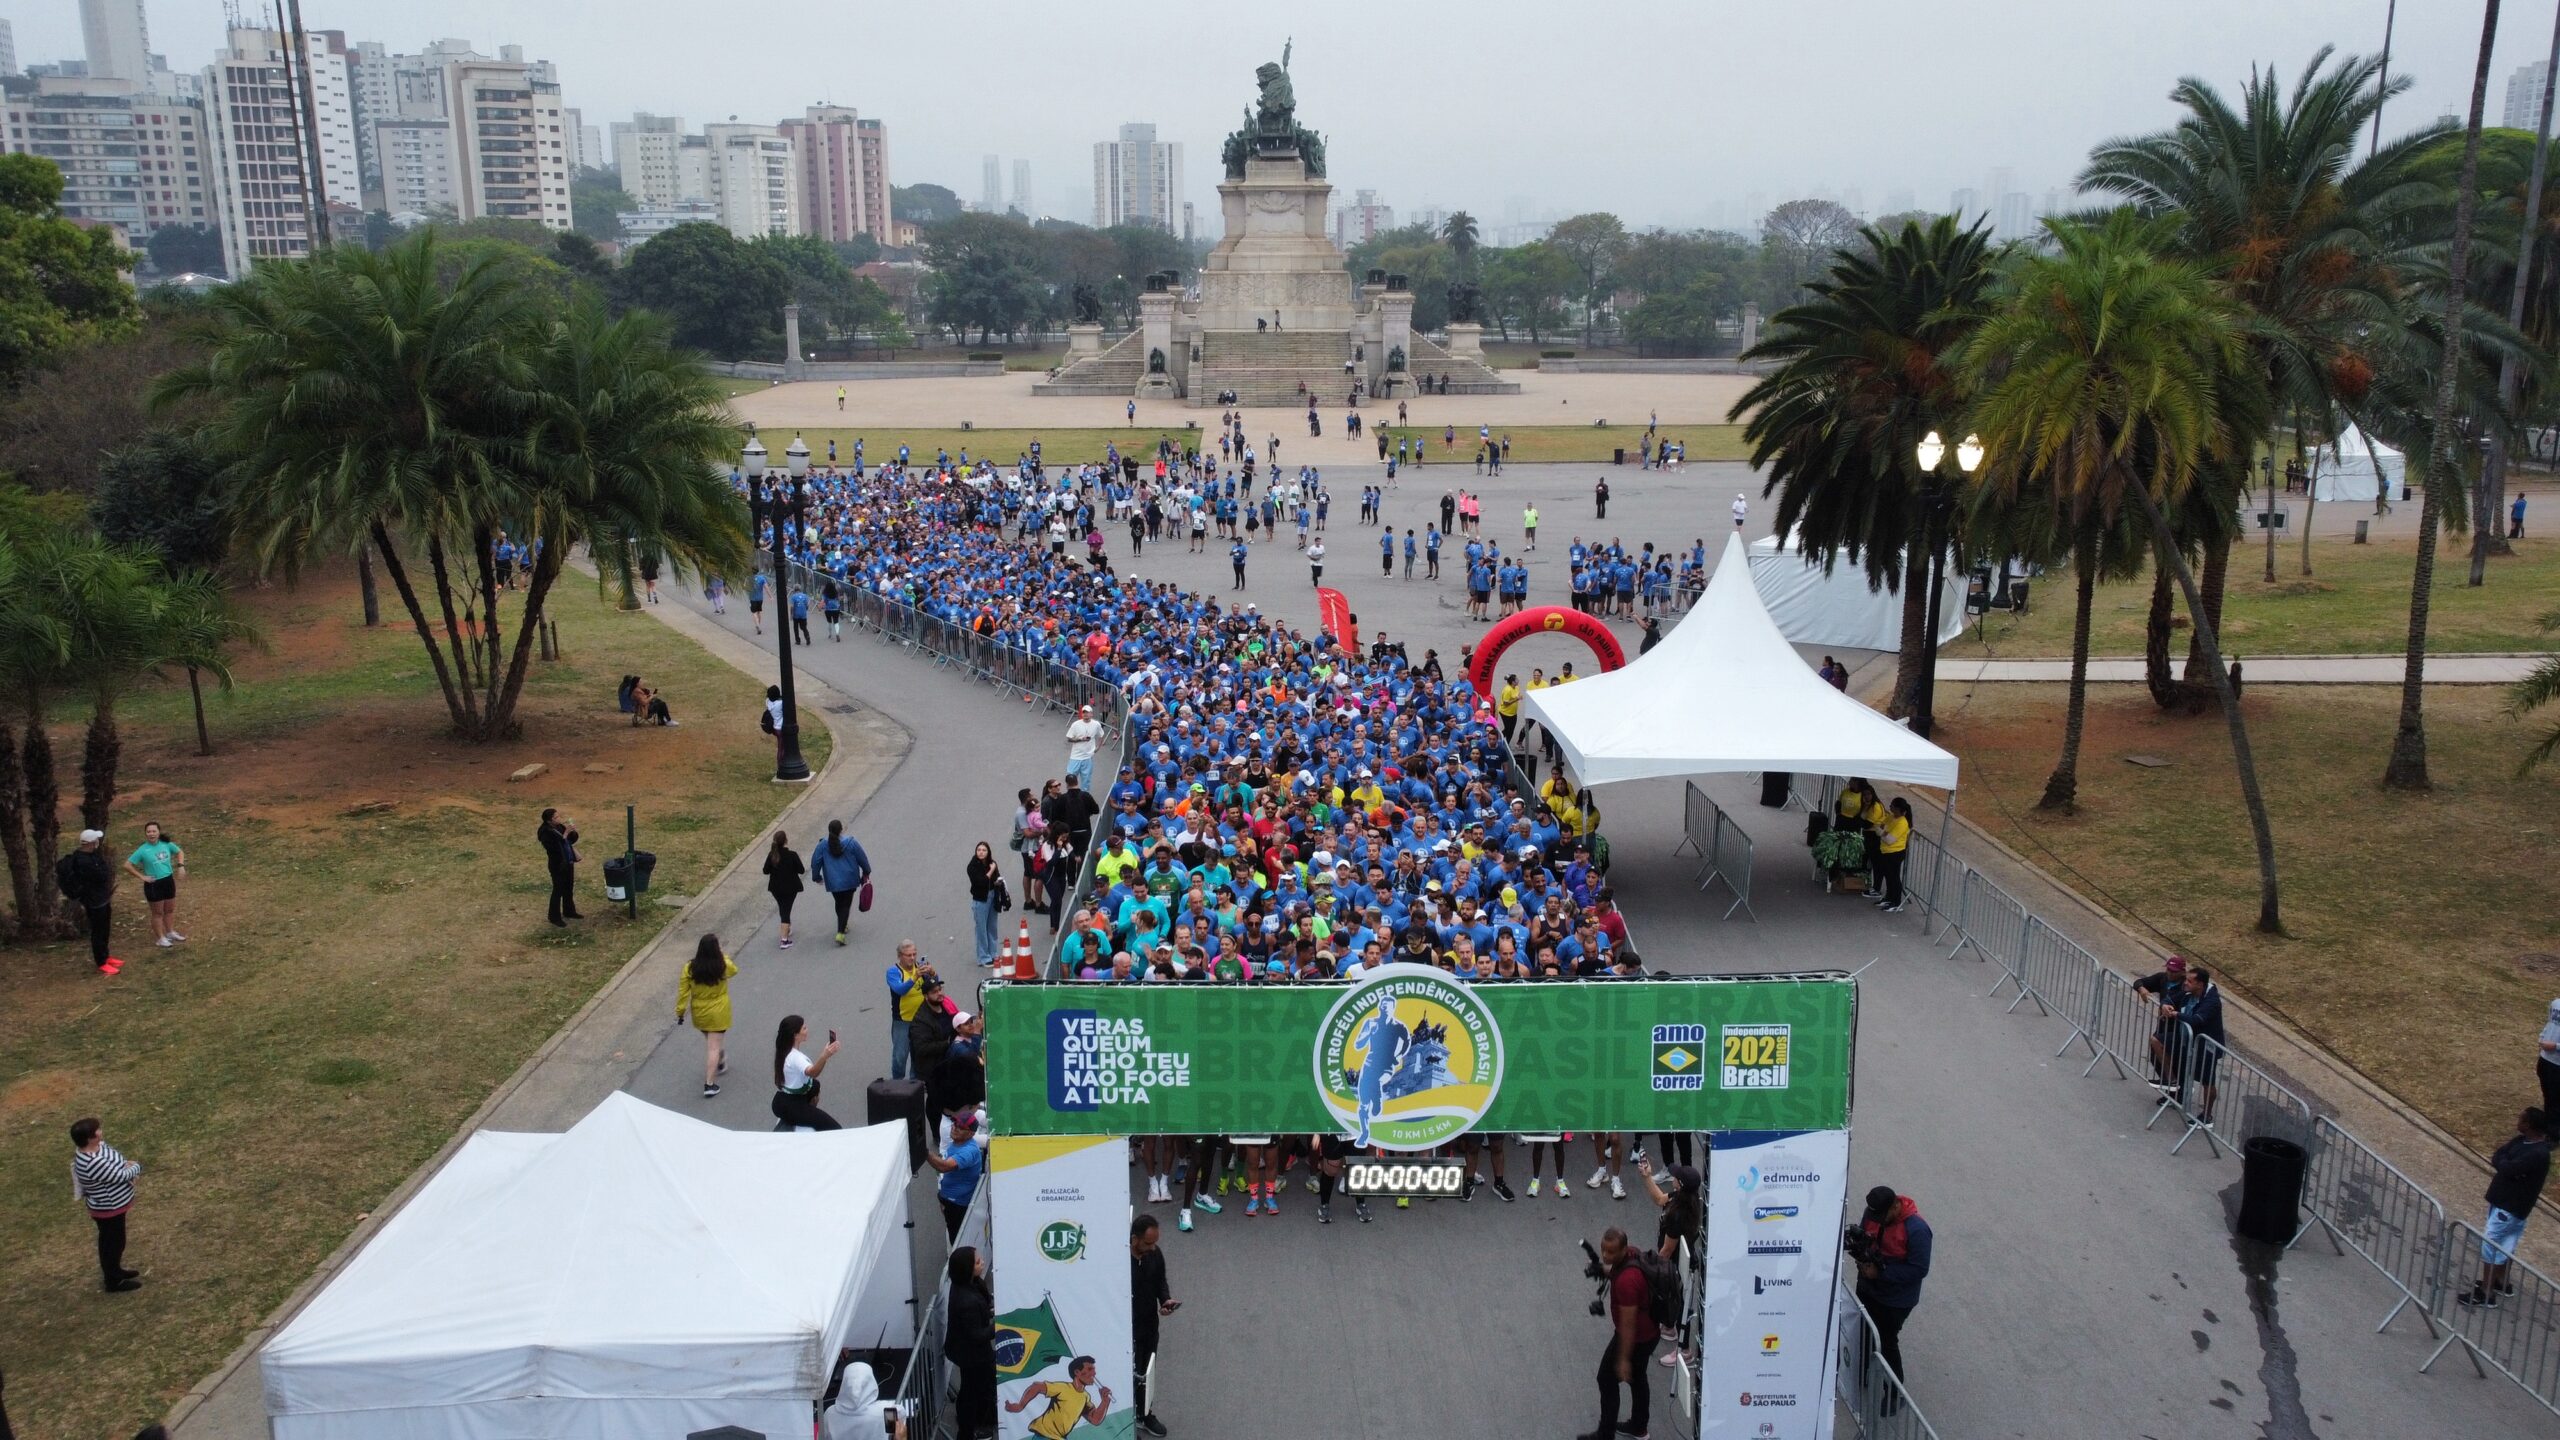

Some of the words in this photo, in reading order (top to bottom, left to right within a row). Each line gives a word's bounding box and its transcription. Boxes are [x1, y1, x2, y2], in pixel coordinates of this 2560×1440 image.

[1594, 633, 1616, 658] PAULO
[1353, 981, 1466, 1014] INDEPENDÊNCIA
[1062, 1018, 1144, 1035] VERAS
[1463, 1011, 1481, 1031] DO
[1327, 1010, 1355, 1065] TROFÉU
[1653, 1025, 1705, 1042] amo
[1724, 1026, 1788, 1036] Independência
[1475, 1031, 1491, 1083] BRASIL
[1724, 1036, 1776, 1065] 202
[1776, 1036, 1787, 1065] anos
[1063, 1053, 1136, 1070] FILHO
[1142, 1053, 1189, 1070] TEU
[1064, 1070, 1116, 1087] NAO
[1124, 1070, 1190, 1087] FOGE
[1328, 1067, 1345, 1094] XIX
[1652, 1076, 1703, 1089] correr
[1723, 1065, 1787, 1086] Brasil
[1063, 1087, 1082, 1104] A
[1088, 1087, 1150, 1104] LUTA
[1392, 1129, 1403, 1138] 10
[1404, 1128, 1421, 1138] KM
[1428, 1127, 1435, 1136] 5
[1435, 1120, 1452, 1134] KM
[1348, 1165, 1461, 1191] 00:00:00
[1763, 1172, 1821, 1183] edmundo
[1041, 1187, 1080, 1195] REALIZAÇÃO
[1763, 1279, 1793, 1287] LIVING
[1753, 1399, 1769, 1407] SÃO
[1770, 1399, 1796, 1407] PAULO
